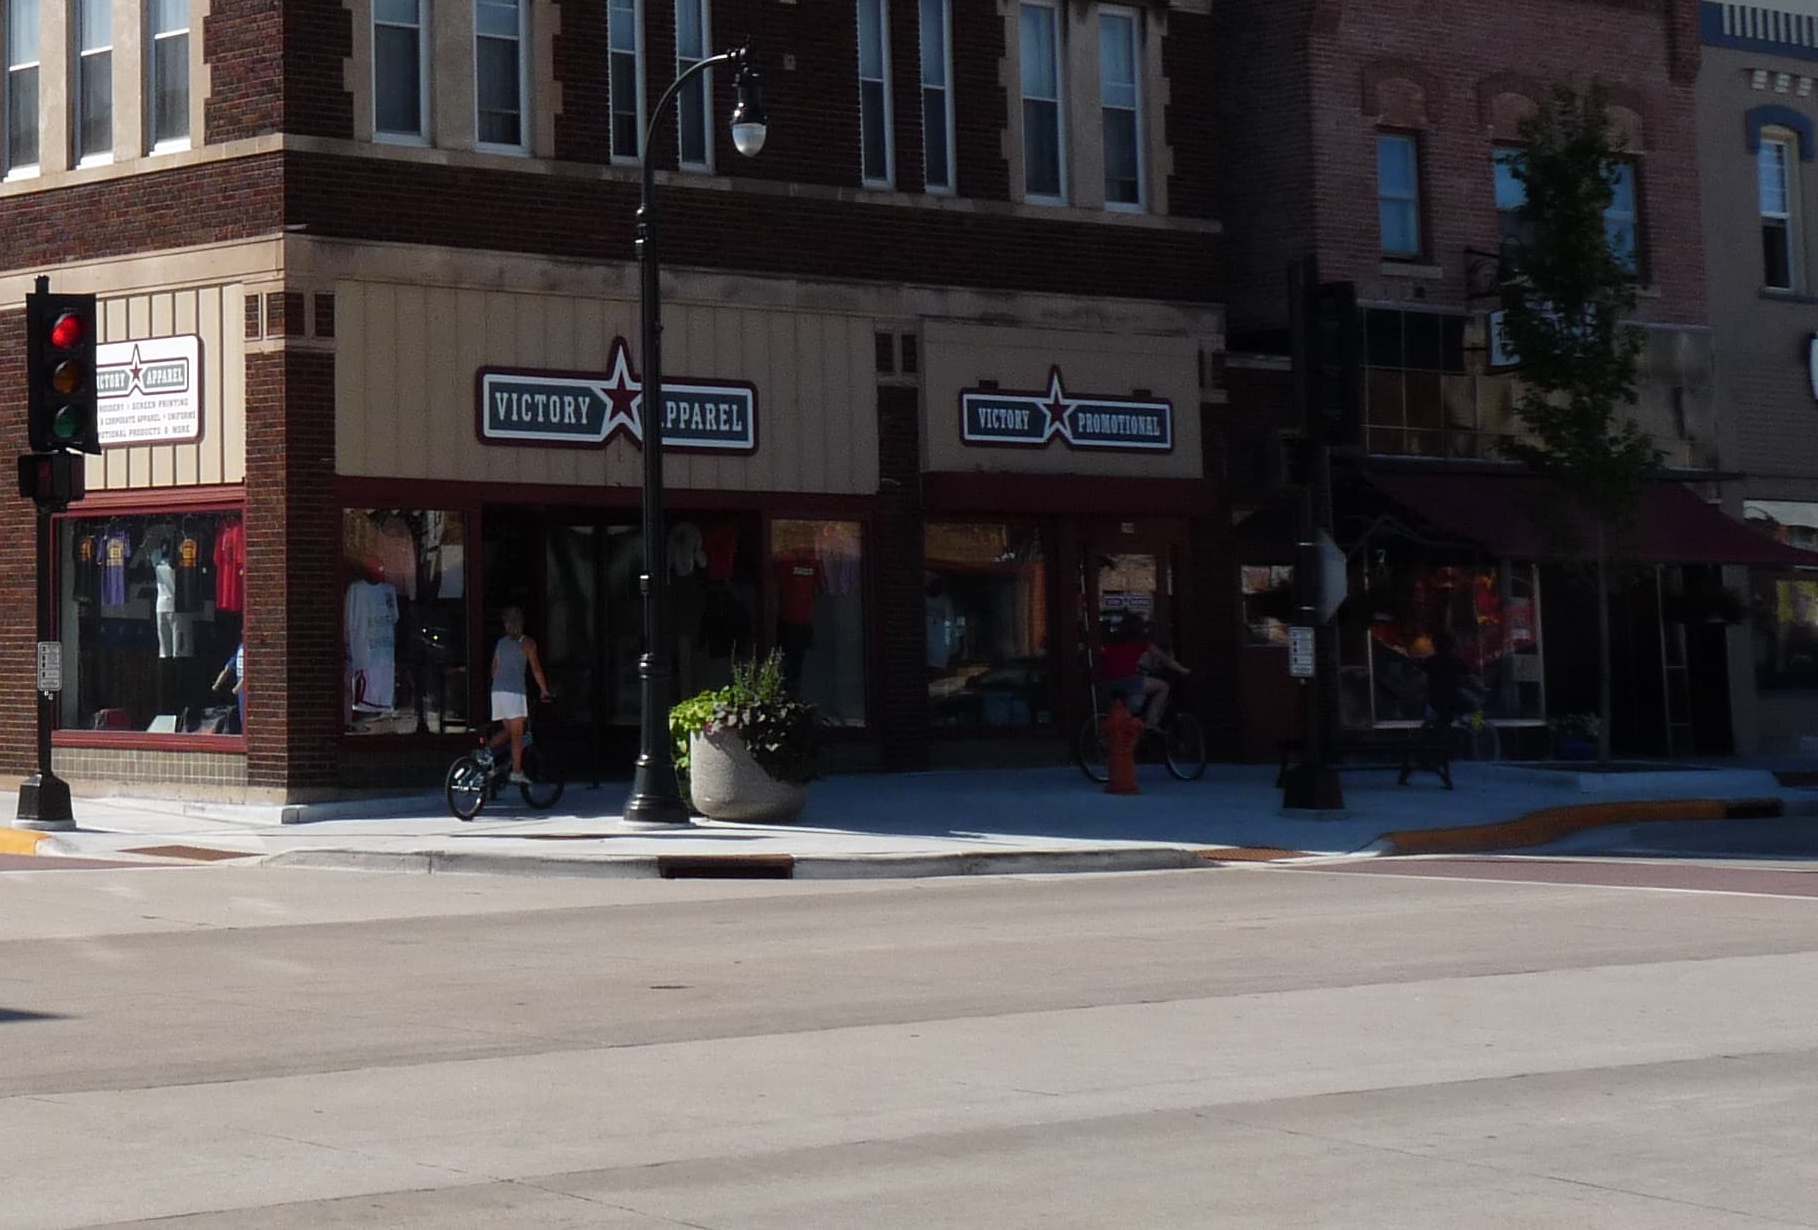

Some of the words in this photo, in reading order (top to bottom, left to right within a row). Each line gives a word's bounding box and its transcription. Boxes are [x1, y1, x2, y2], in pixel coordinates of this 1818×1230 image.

[96, 373, 126, 390] ICTORY
[146, 368, 184, 385] APPAREL
[132, 401, 156, 411] SCREEN
[158, 398, 189, 409] PRINTING
[494, 391, 591, 425] VICTORY
[661, 400, 743, 432] PPAREL
[105, 415, 136, 426] CORPORATE
[137, 413, 162, 423] APPAREL
[167, 410, 196, 420] UNIFORMS
[978, 407, 1030, 431] VICTORY
[1077, 413, 1161, 437] PROMOTIONAL
[128, 427, 162, 437] PRODUCTS
[172, 425, 190, 434] MORE
